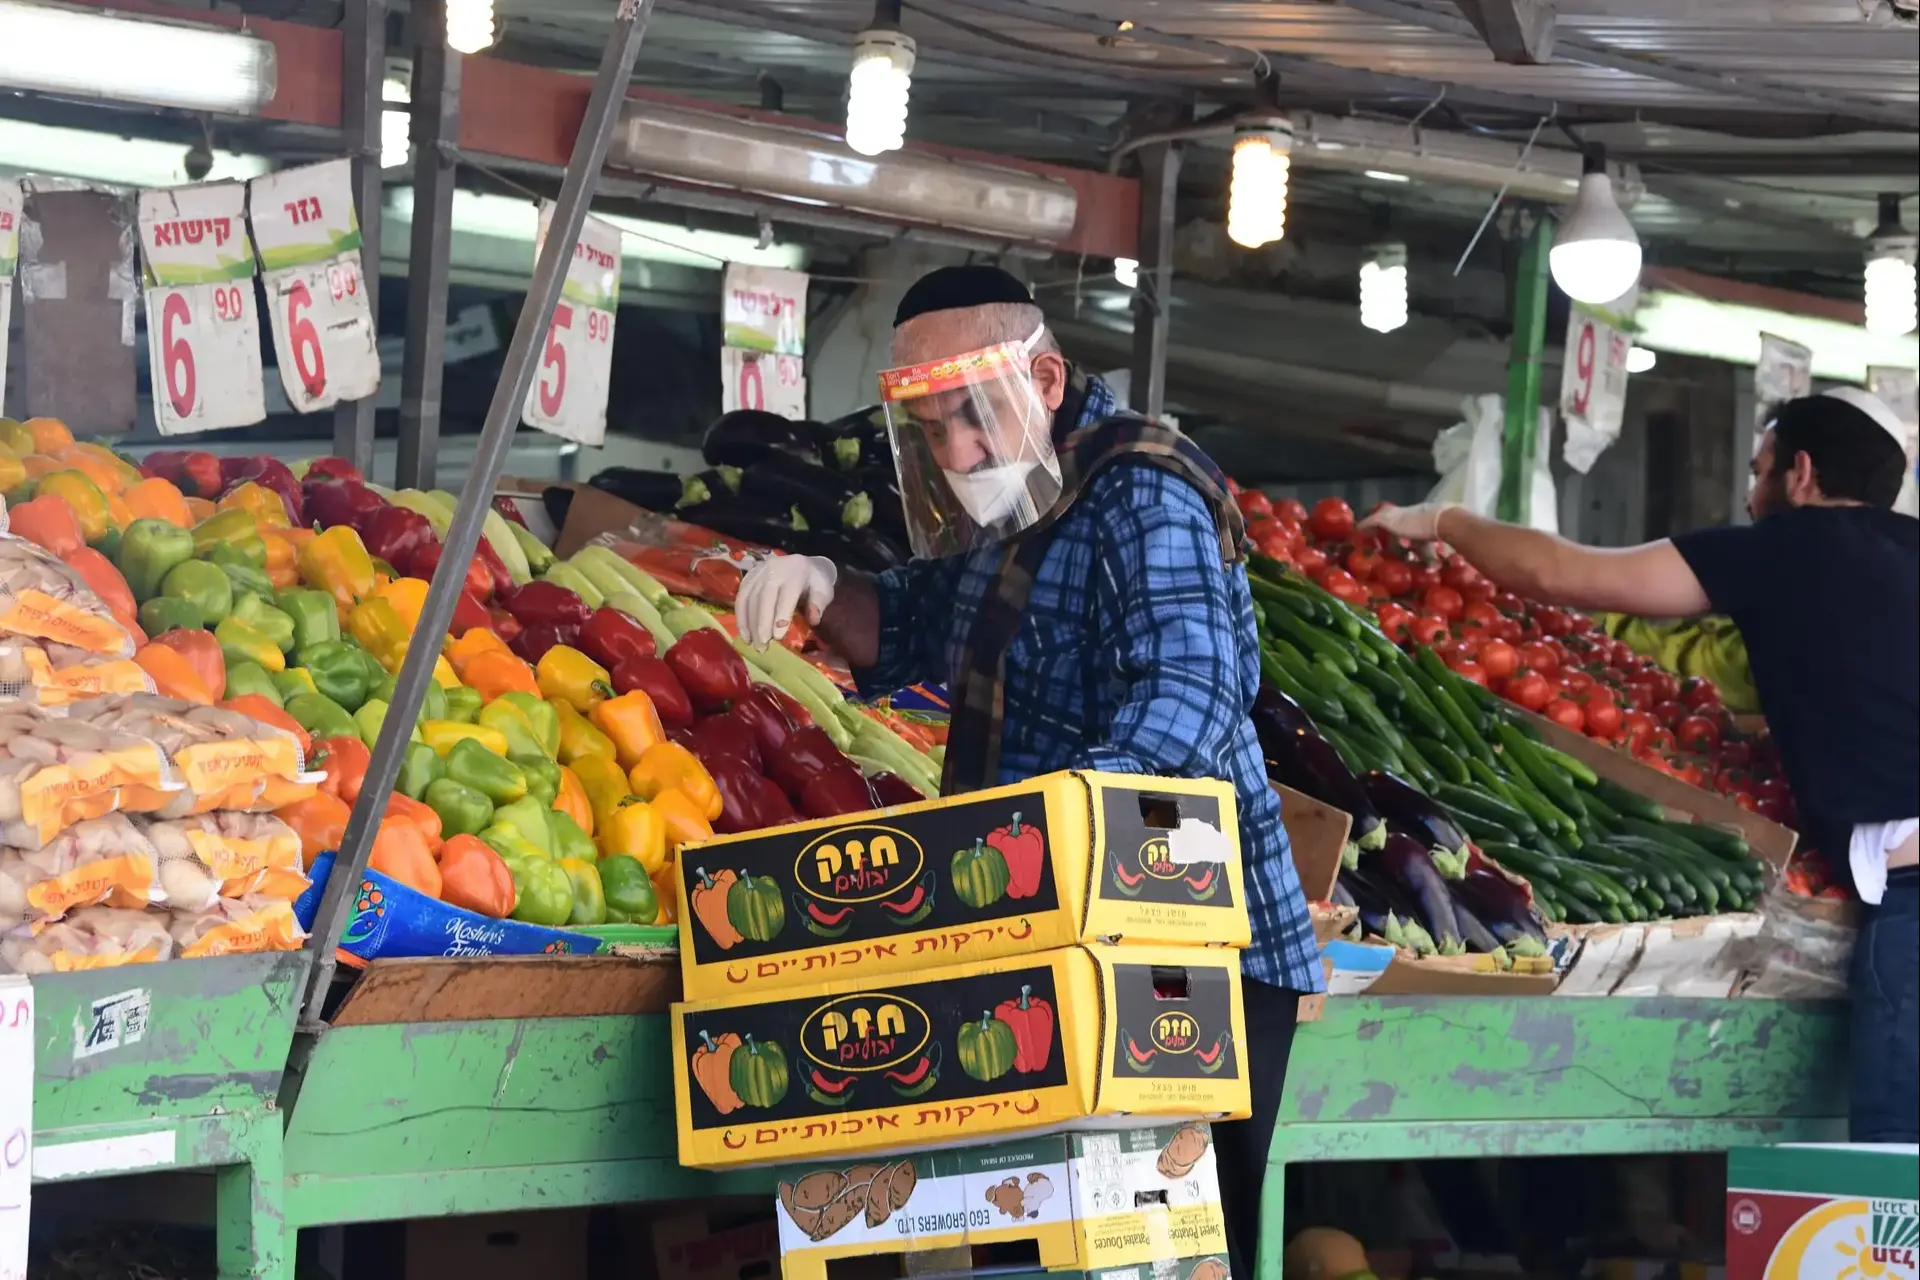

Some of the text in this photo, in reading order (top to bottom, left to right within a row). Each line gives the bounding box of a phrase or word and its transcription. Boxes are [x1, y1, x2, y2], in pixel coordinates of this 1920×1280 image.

[284, 196, 323, 226] גזר
[154, 217, 231, 248] קישוא
[586, 244, 615, 270] חציל
[214, 287, 243, 321] 90
[288, 279, 326, 398] 6
[588, 311, 609, 343] 90
[162, 292, 196, 418] 6
[540, 304, 573, 418] 5
[815, 834, 900, 884] חזק
[1147, 844, 1170, 866] זק
[835, 857, 889, 896] יבולים
[444, 917, 505, 945] Moshav's
[443, 940, 492, 956] Fruits
[757, 926, 1004, 978] ירקות איכותיים
[822, 1003, 906, 1051] חזק
[1159, 1018, 1191, 1041] חזק
[840, 1026, 896, 1062] יבולים
[756, 1099, 1010, 1145] ירקות איכותיים
[980, 1152, 1034, 1167] PRODUCE OF ISRAEL
[895, 1208, 991, 1234] EGO GROWERS LTD.
[1871, 1200, 1909, 1215] הנגב
[1094, 1234, 1123, 1249] Douces
[1198, 1223, 1221, 1237] Sweet
[1871, 1246, 1915, 1270] חבל
